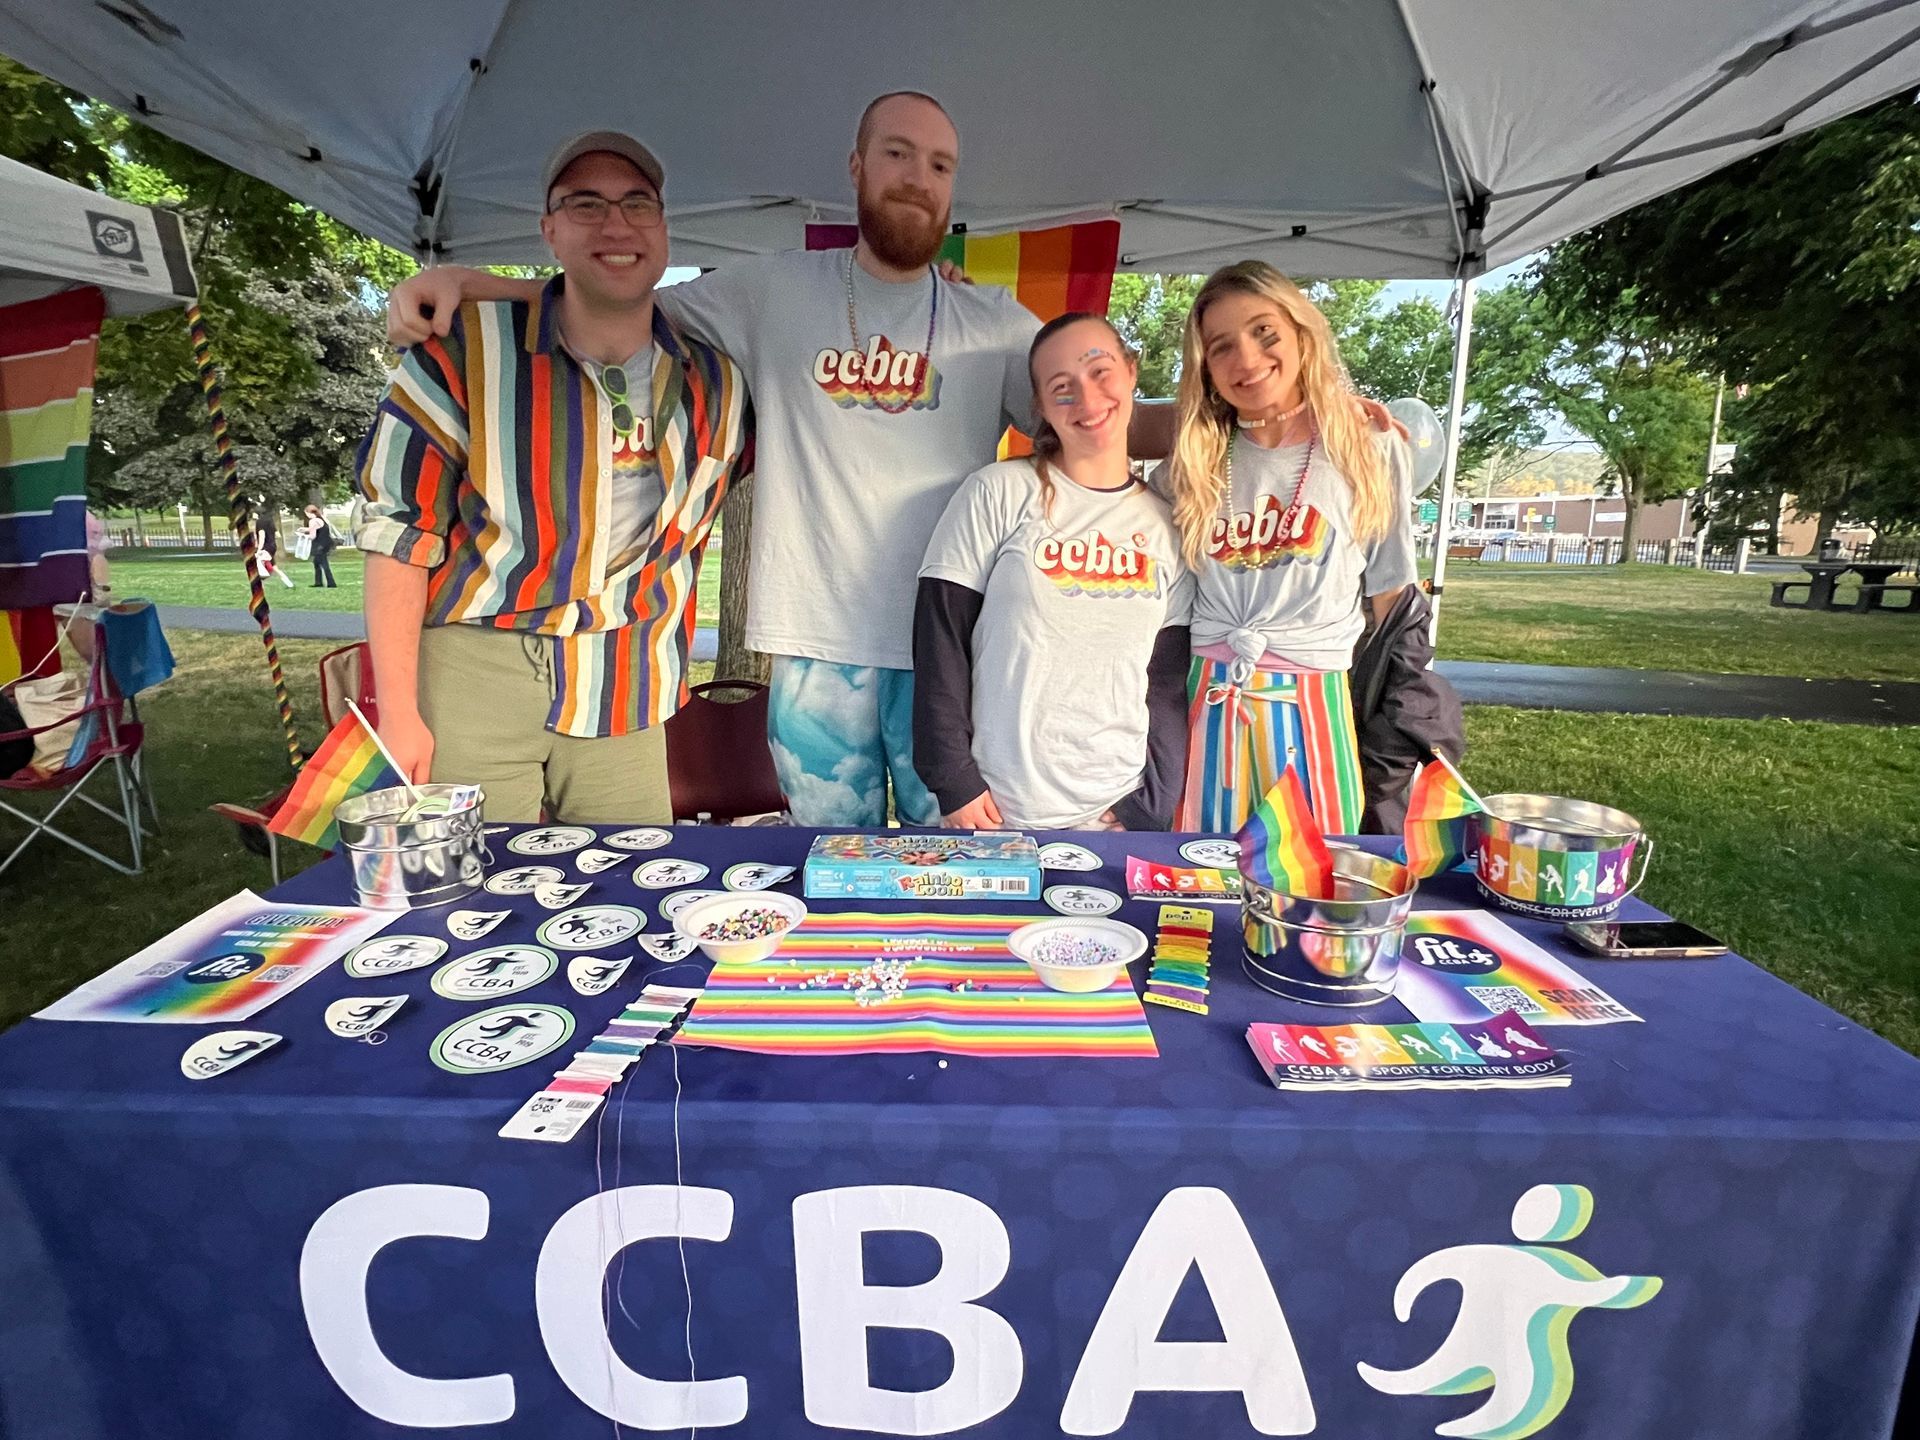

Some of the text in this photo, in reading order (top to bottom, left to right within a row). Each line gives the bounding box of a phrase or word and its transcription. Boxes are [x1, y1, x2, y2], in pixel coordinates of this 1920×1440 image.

[812, 333, 922, 388] ccba
[1203, 494, 1311, 556] ccba
[1034, 529, 1140, 576] ccba
[646, 875, 687, 883] CCBA
[915, 884, 964, 897] Loom
[1061, 901, 1108, 909] CCBA
[1499, 898, 1542, 915] SPORTS
[1544, 907, 1569, 918] FOR
[1571, 906, 1604, 918] EVERY
[572, 925, 629, 943] CCBA
[653, 949, 686, 958] CCBA
[1414, 937, 1466, 966] fit
[362, 958, 414, 968] CCBA
[454, 977, 514, 988] CCBA
[576, 977, 607, 989] CCBA
[1538, 988, 1609, 1004] SCAN
[1564, 1005, 1631, 1021] HERE
[336, 1020, 375, 1031] CCBA
[453, 1038, 511, 1063] CCBA
[1288, 1060, 1556, 1076] CCBA SPORTS FOR EVERY BODY
[299, 1183, 1317, 1437] CCBA
